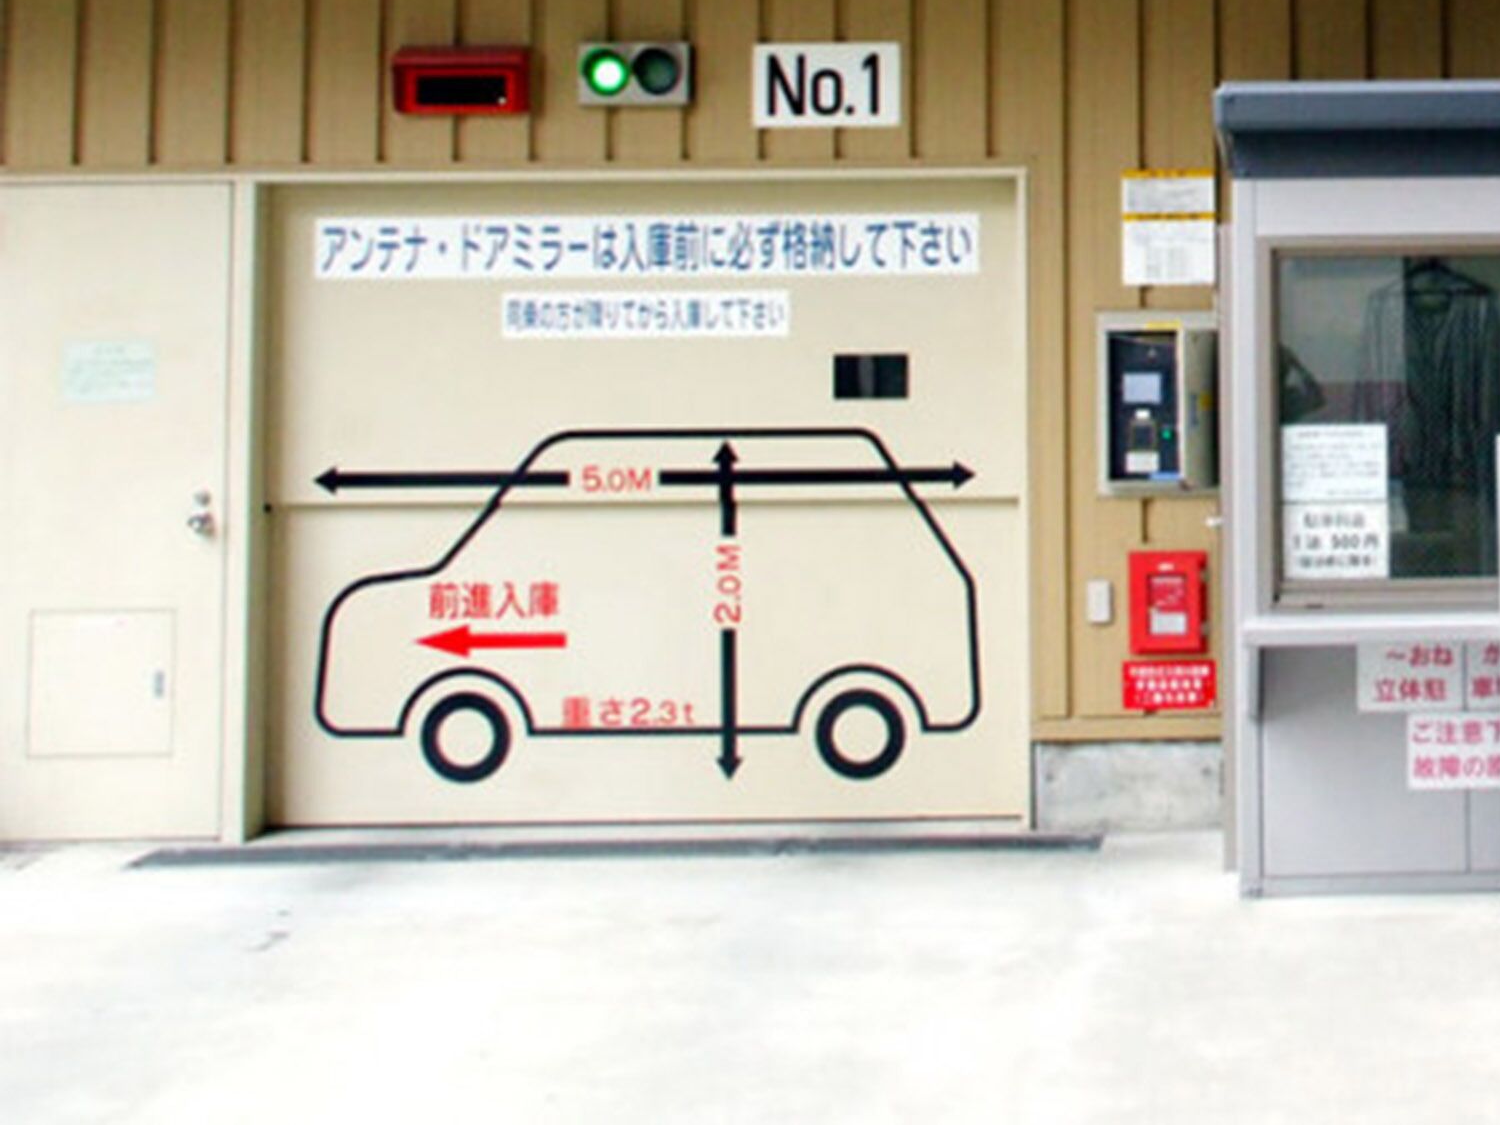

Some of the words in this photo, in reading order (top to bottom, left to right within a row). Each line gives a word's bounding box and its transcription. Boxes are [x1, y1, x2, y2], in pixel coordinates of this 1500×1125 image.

[765, 52, 882, 118] No.1
[320, 219, 974, 274] アンテナ・ドアミラーは入庫前に必ず格納して下さい
[581, 466, 653, 493] 5.0M
[428, 581, 560, 620] 前進入庫
[714, 544, 742, 624] 2.0M
